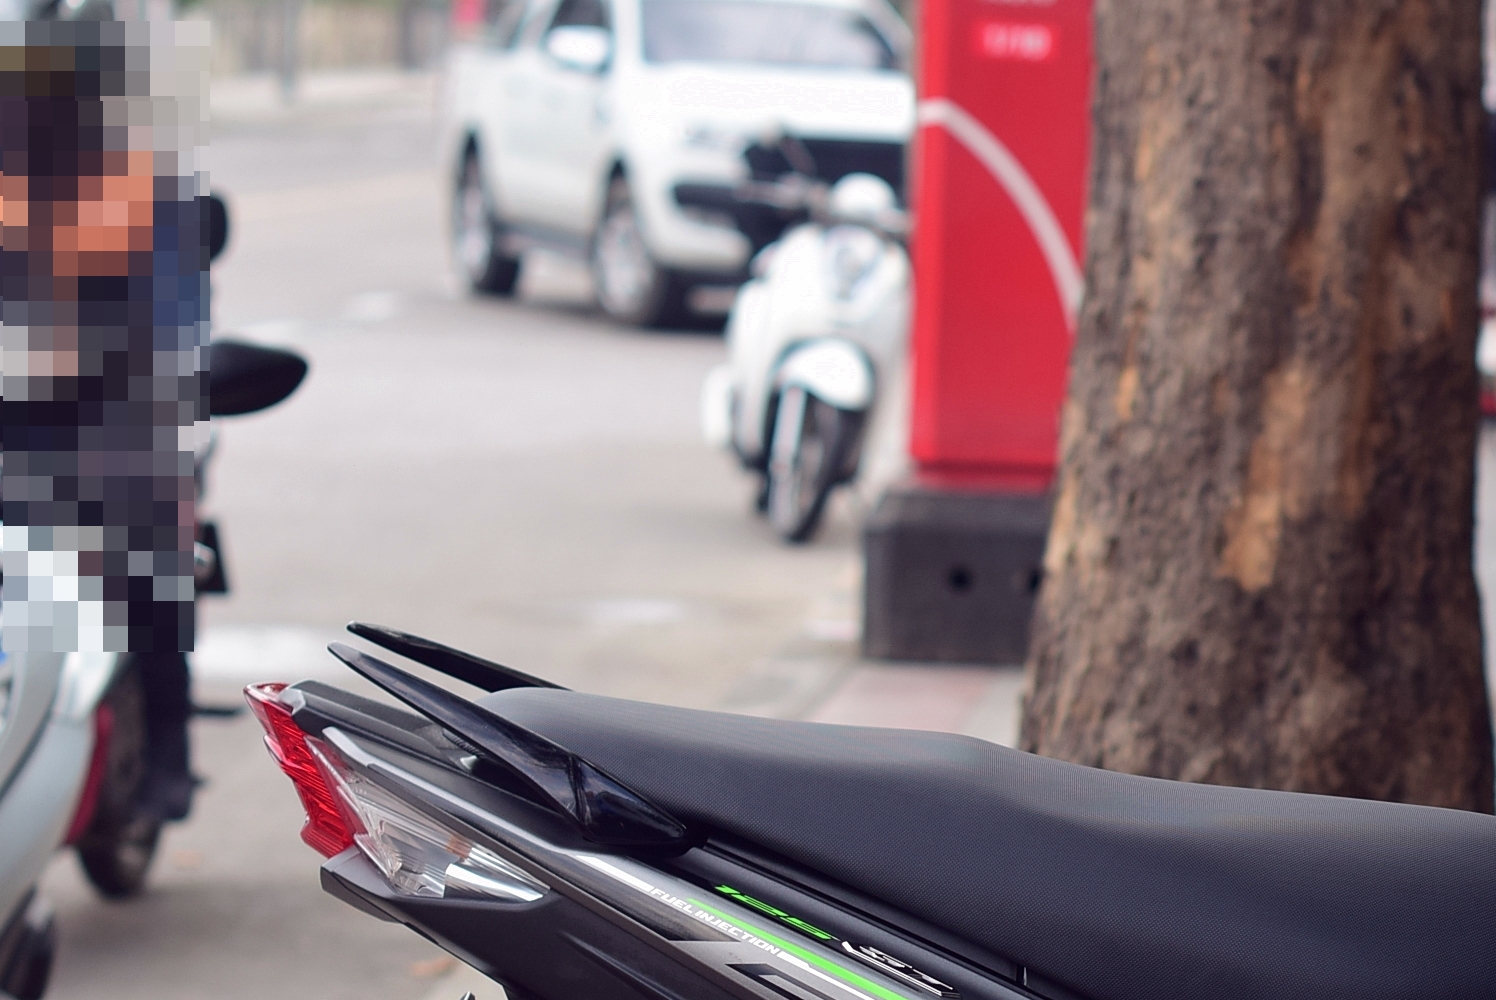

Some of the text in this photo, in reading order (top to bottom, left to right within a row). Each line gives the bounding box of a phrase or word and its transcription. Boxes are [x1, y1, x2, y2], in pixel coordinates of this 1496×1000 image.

[650, 885, 782, 955] FUEL INJECTION
[714, 884, 840, 941] 125
